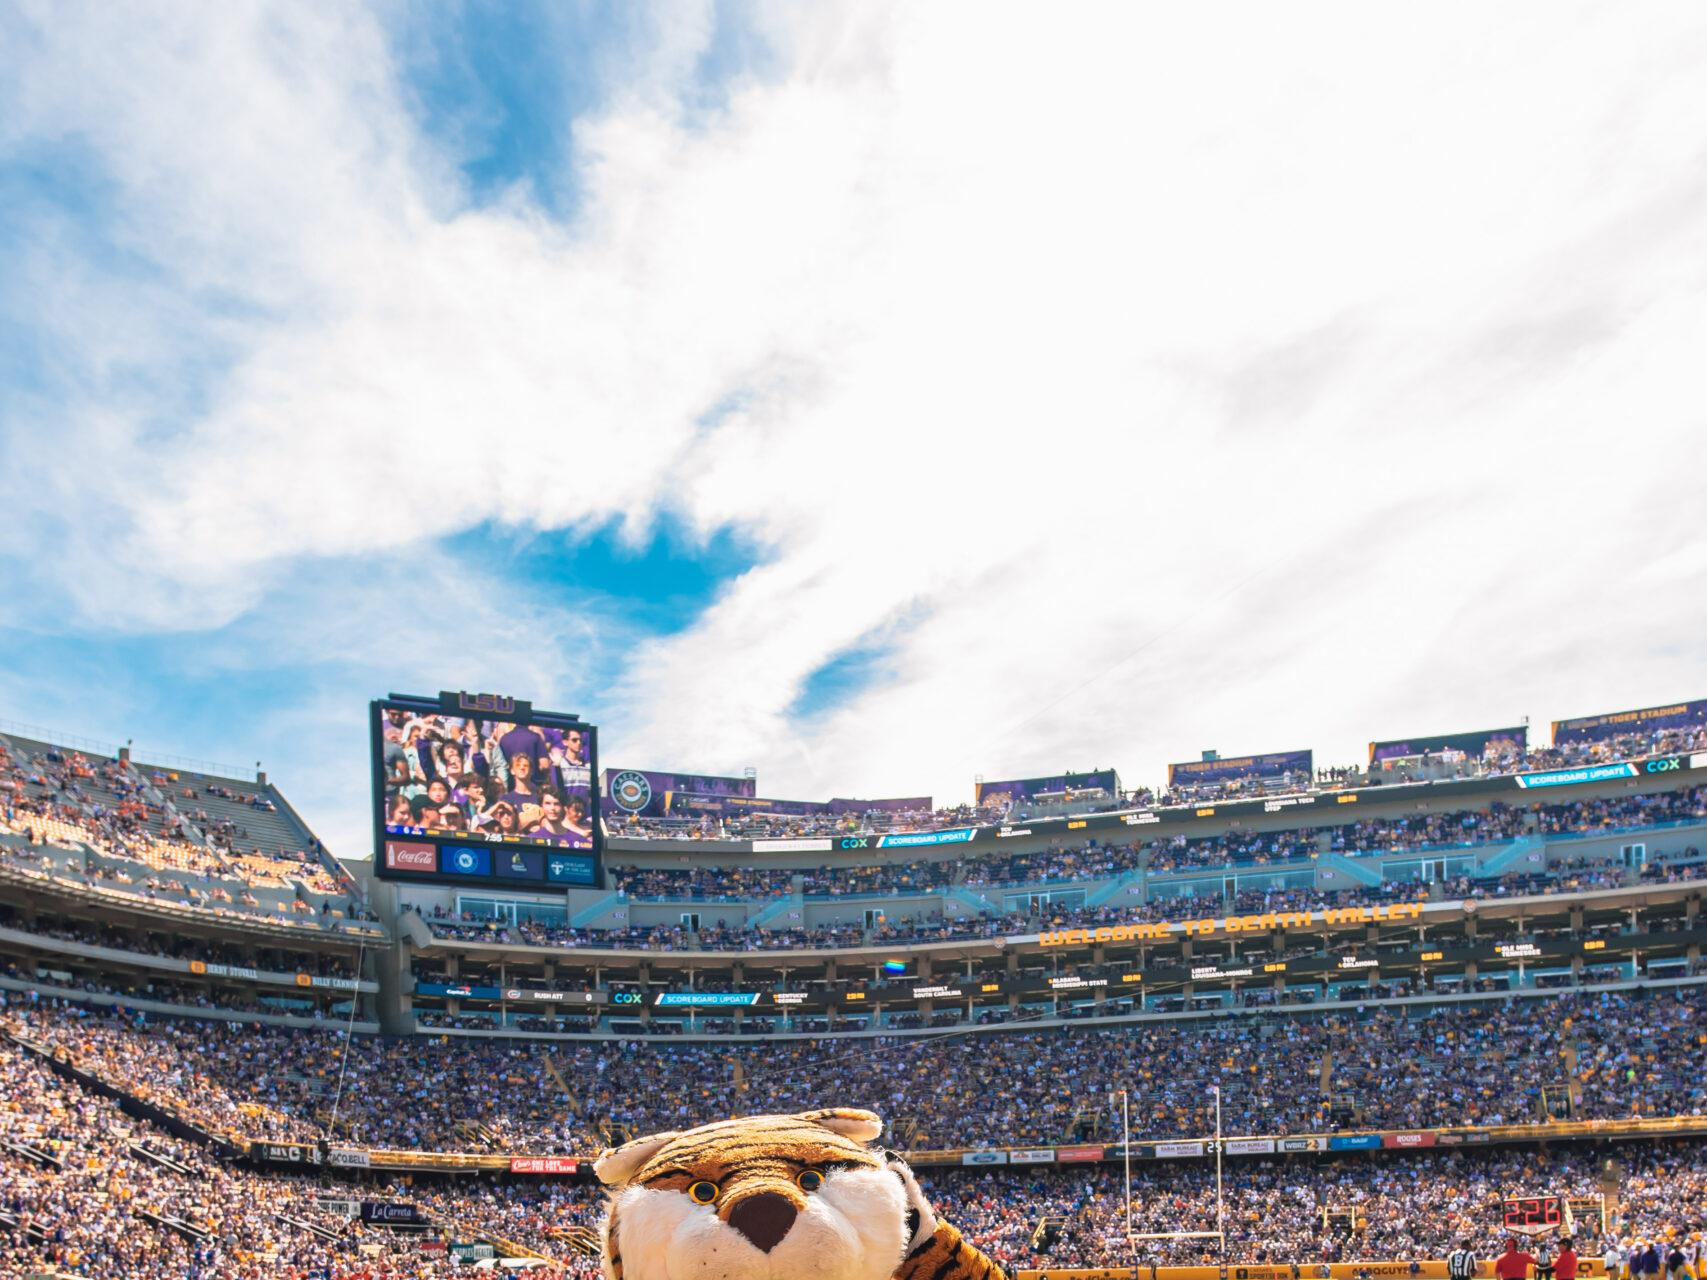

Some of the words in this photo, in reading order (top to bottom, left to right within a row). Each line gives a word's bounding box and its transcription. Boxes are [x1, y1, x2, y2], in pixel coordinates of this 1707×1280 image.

[459, 690, 516, 714] LSU
[1608, 712, 1639, 724] TIGER
[1640, 705, 1688, 720] STADIUM
[1647, 758, 1680, 773] COX
[616, 772, 648, 790] CAESARS
[1529, 772, 1588, 785] SCOREBOARD
[1590, 767, 1625, 779] UPDATE
[841, 838, 869, 849] COX
[888, 834, 937, 846] SCOREBOARD
[938, 831, 968, 842] UPDATE
[398, 850, 433, 865] Coca-Cola
[1039, 922, 1169, 947] WELCOME
[1181, 919, 1214, 936] TO
[1224, 911, 1312, 932] DEATH
[1322, 903, 1425, 925] VALLEY
[1342, 960, 1379, 968] OKLAHOMA
[312, 977, 330, 987] BILLY
[913, 986, 948, 994] VANDERBILT
[585, 994, 592, 1002] 0
[614, 993, 642, 1003] COX
[667, 994, 718, 1003] SCOREBOARD
[719, 995, 749, 1003] UPDATE
[1396, 1135, 1421, 1143] ROUSES
[1176, 1143, 1198, 1151] BUREAU
[329, 1150, 348, 1163] TACO
[349, 1152, 367, 1165] BELL
[331, 1203, 349, 1215] POWER
[371, 1203, 383, 1219] La
[383, 1203, 411, 1219] Carreta
[474, 1247, 493, 1258] HEALTH
